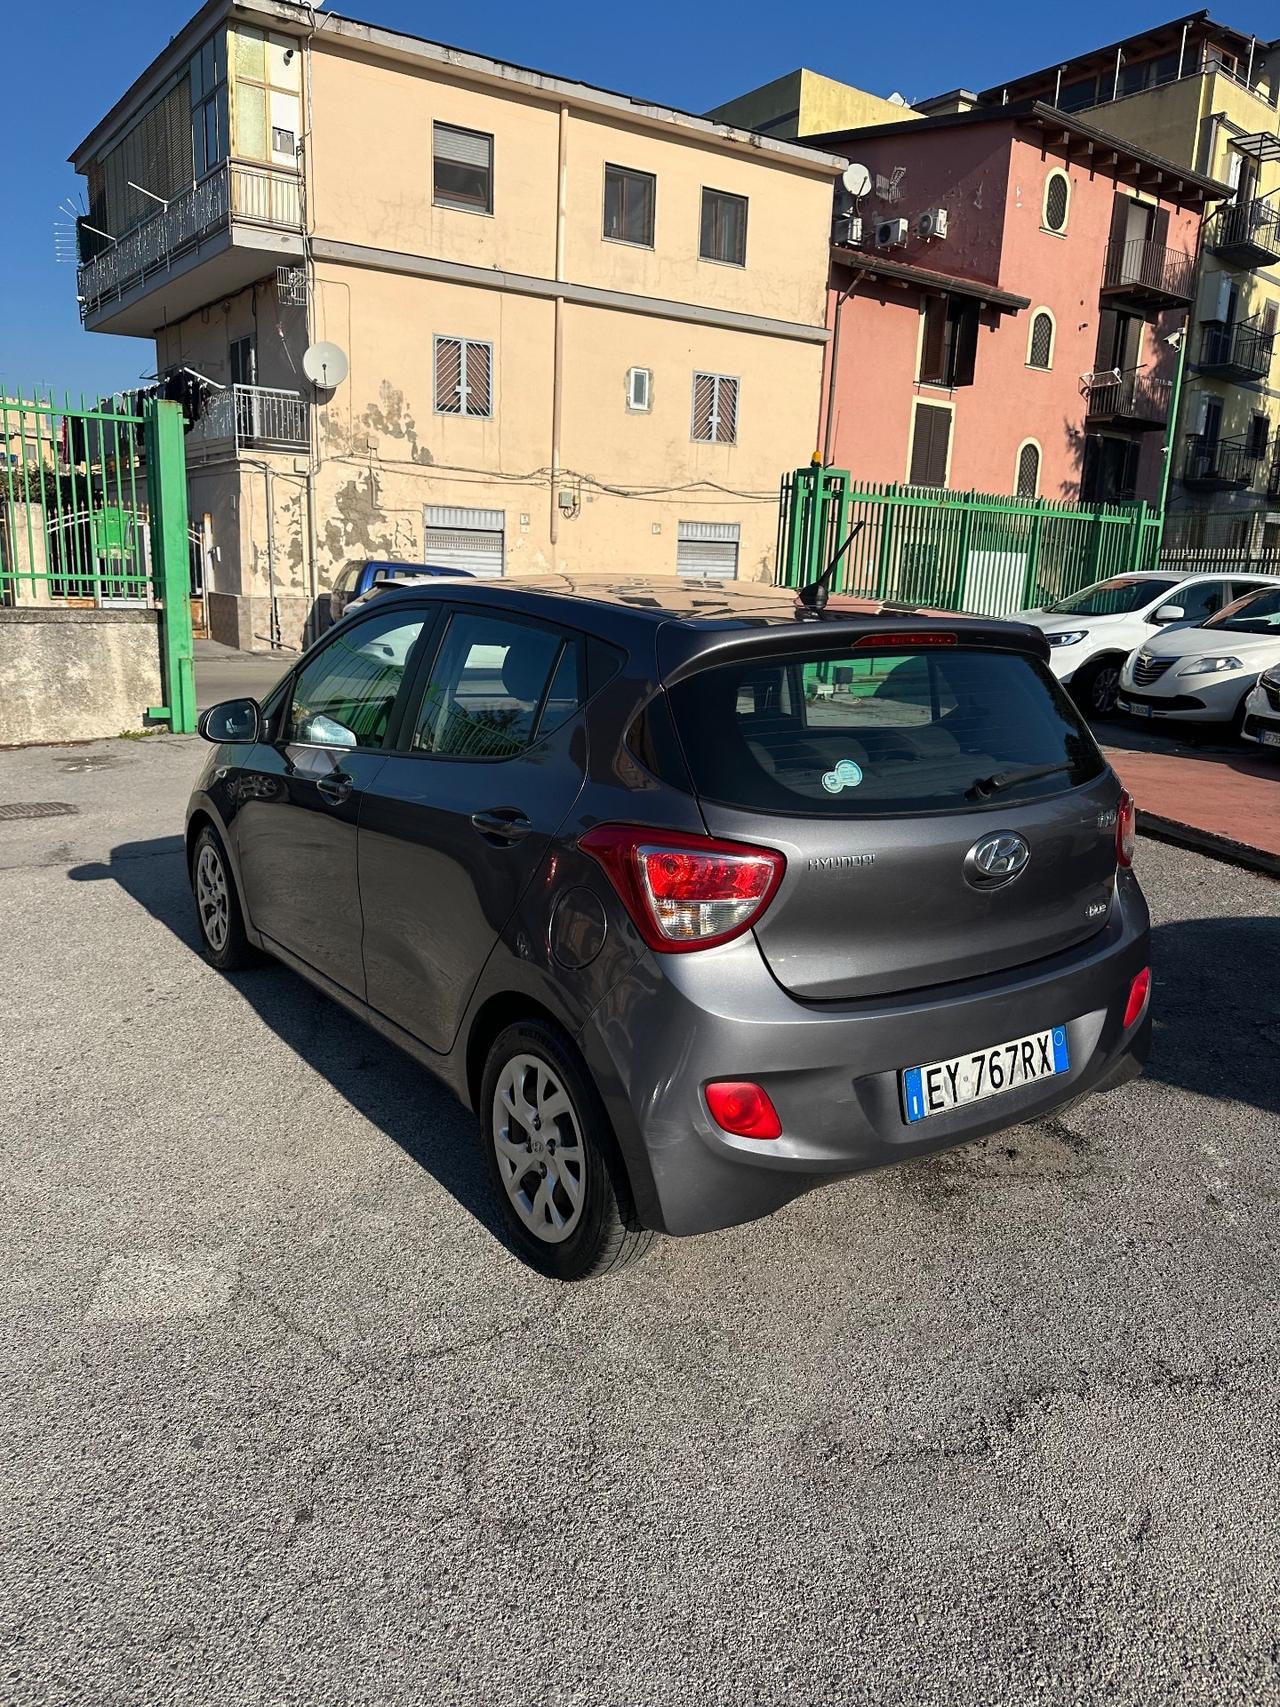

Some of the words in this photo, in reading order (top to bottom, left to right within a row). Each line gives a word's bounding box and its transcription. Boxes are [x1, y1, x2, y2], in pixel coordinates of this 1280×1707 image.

[807, 853, 876, 871] HYUNDAI
[926, 1062, 959, 1110] EY
[971, 1034, 1052, 1097] 767RX
